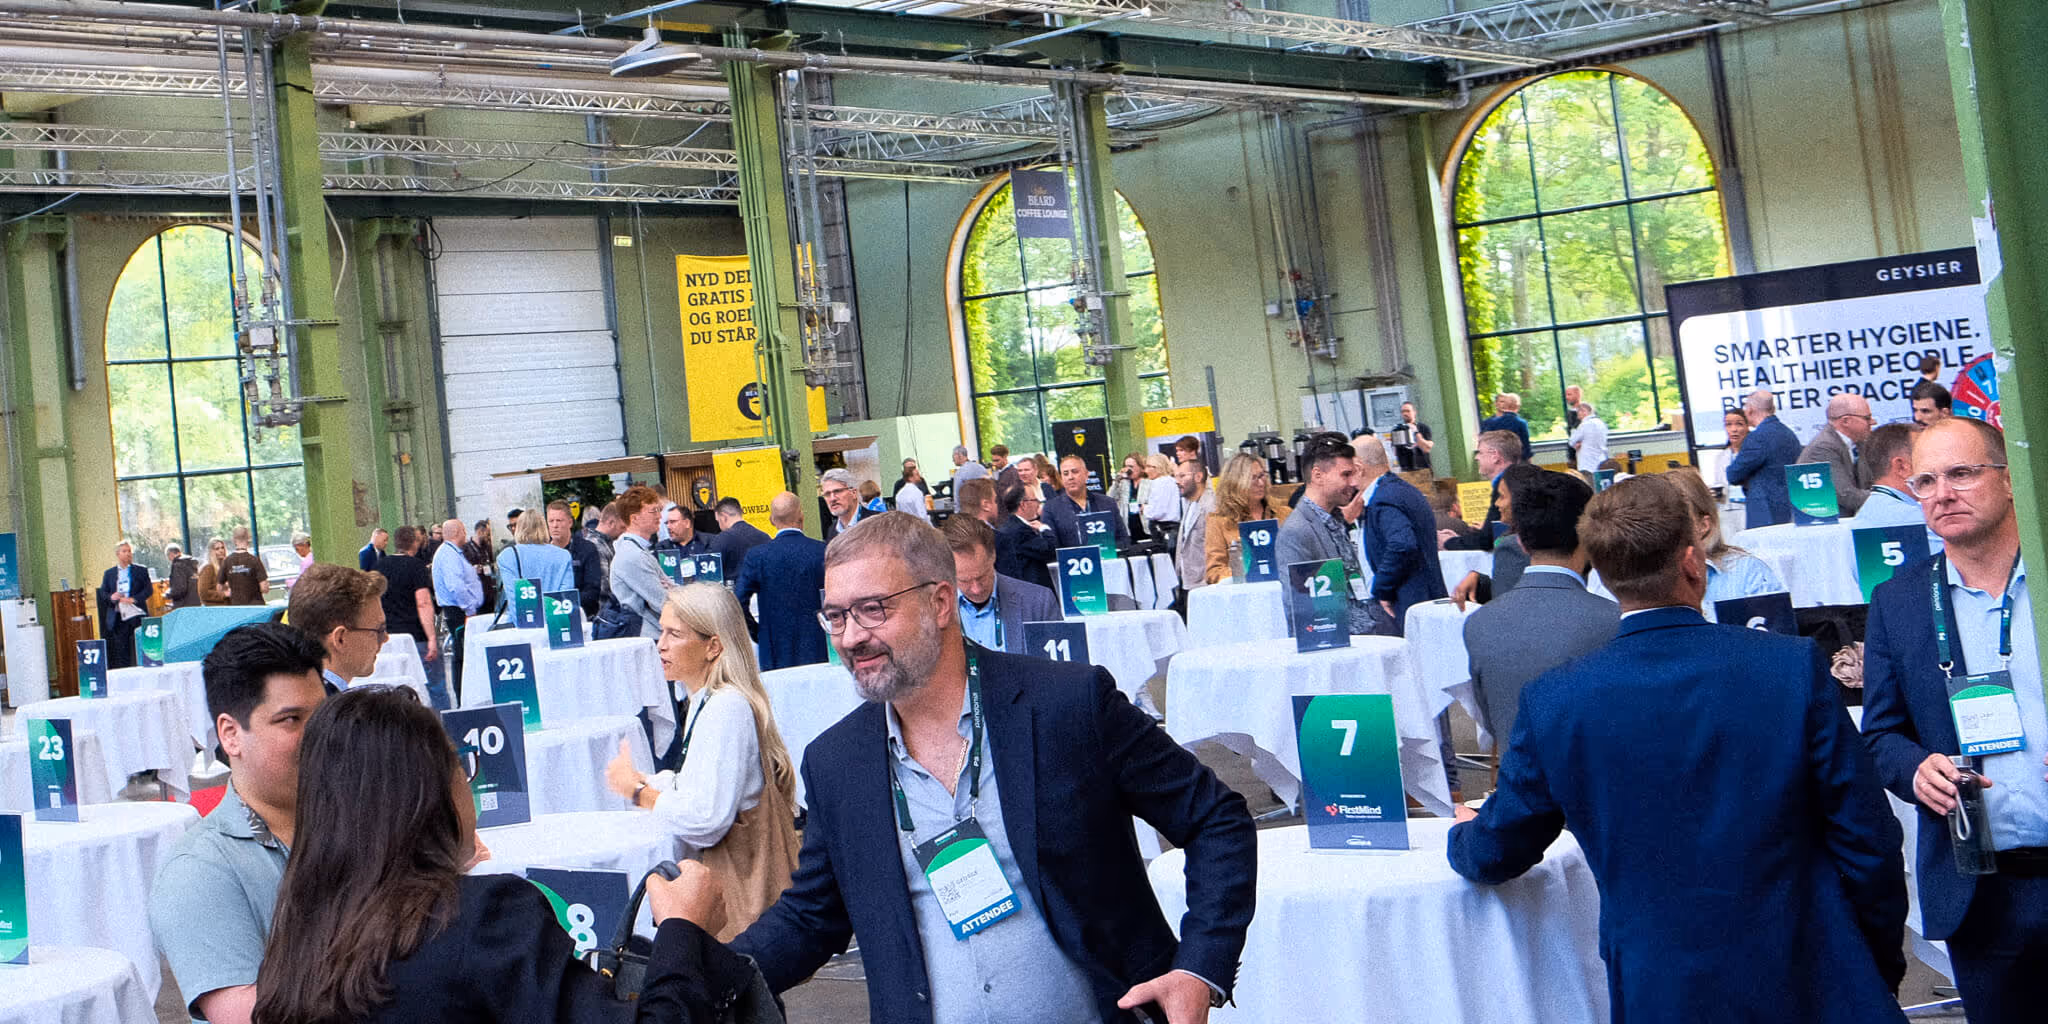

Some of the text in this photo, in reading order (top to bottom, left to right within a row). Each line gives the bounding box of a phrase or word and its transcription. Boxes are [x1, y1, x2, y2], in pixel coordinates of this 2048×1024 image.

[1028, 195, 1055, 206] BEARD
[1016, 208, 1043, 217] COFFEE
[1876, 261, 1962, 281] GEYSIER
[685, 273, 719, 287] NYD
[687, 289, 745, 306] GRATIS
[689, 312, 711, 325] OG
[691, 326, 756, 345] DU STÅR
[1714, 318, 1980, 364] SMARTER HYGIENE.
[1718, 356, 1863, 390] HEALTHIER
[1721, 388, 1821, 413] BETER
[1798, 472, 1823, 489] 15
[742, 504, 770, 514] OWBEA
[1085, 521, 1106, 534] 32
[1249, 529, 1271, 546] 19
[1881, 542, 1905, 567] 5
[700, 561, 716, 574] 34
[1067, 557, 1093, 576] 20
[520, 586, 537, 599] 35
[1304, 575, 1333, 598] 12
[552, 599, 573, 615] 29
[145, 625, 159, 638] 45
[83, 649, 100, 664] 37
[1044, 639, 1071, 662] 11
[497, 658, 526, 681] 22
[463, 725, 504, 755] 10
[1331, 719, 1357, 756] 7
[38, 735, 65, 761] 23
[1968, 740, 2020, 753] ATTENDEE
[1339, 804, 1382, 814] FirstMind
[961, 899, 1015, 934] ATTENDEE
[566, 903, 598, 952] 8
